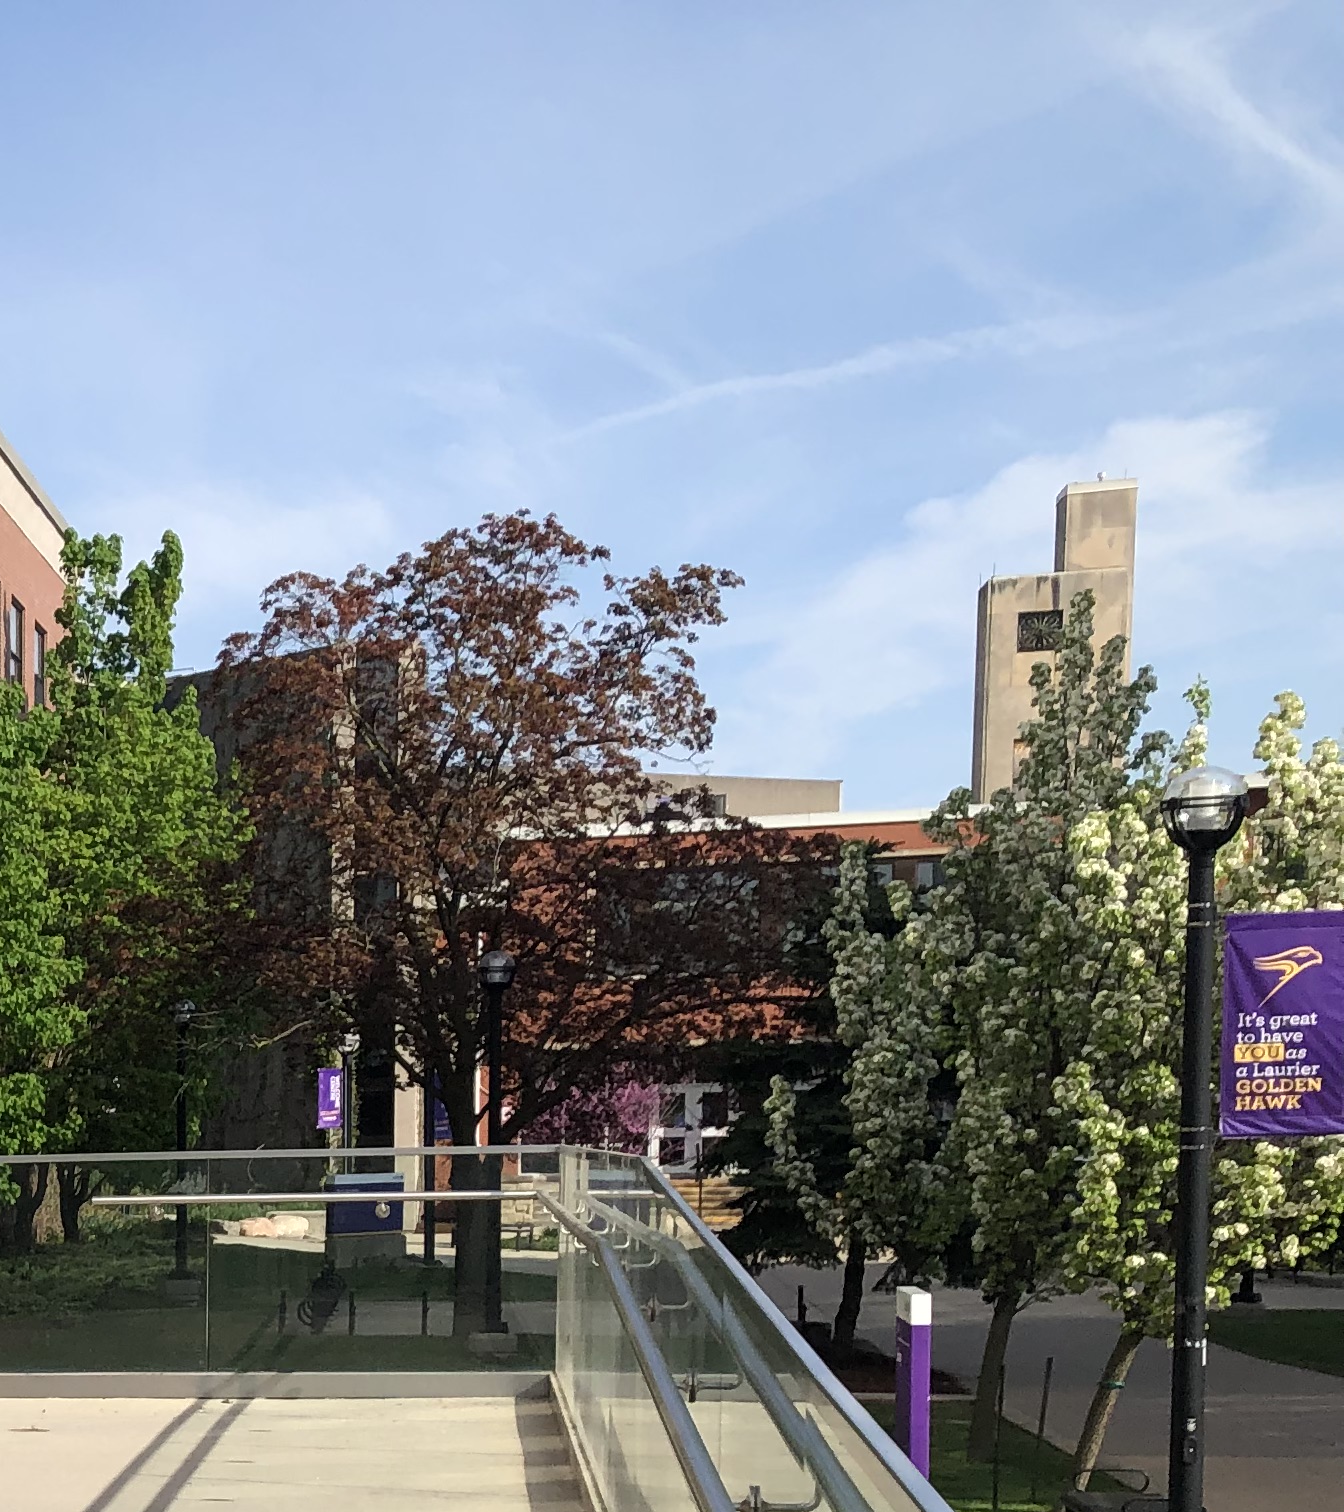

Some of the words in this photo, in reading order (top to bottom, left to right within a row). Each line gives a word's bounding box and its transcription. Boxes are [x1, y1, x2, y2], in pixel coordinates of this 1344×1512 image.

[1238, 1012, 1265, 1028] It's
[1269, 1012, 1318, 1030] great
[1236, 1031, 1255, 1043] to
[1260, 1028, 1303, 1043] have
[1237, 1046, 1280, 1059] YOU
[1286, 1048, 1307, 1059] as
[1236, 1066, 1248, 1077] a
[1253, 1062, 1320, 1077] Laurier
[1236, 1078, 1322, 1094] GOLDEN
[1235, 1095, 1301, 1111] HAWK
